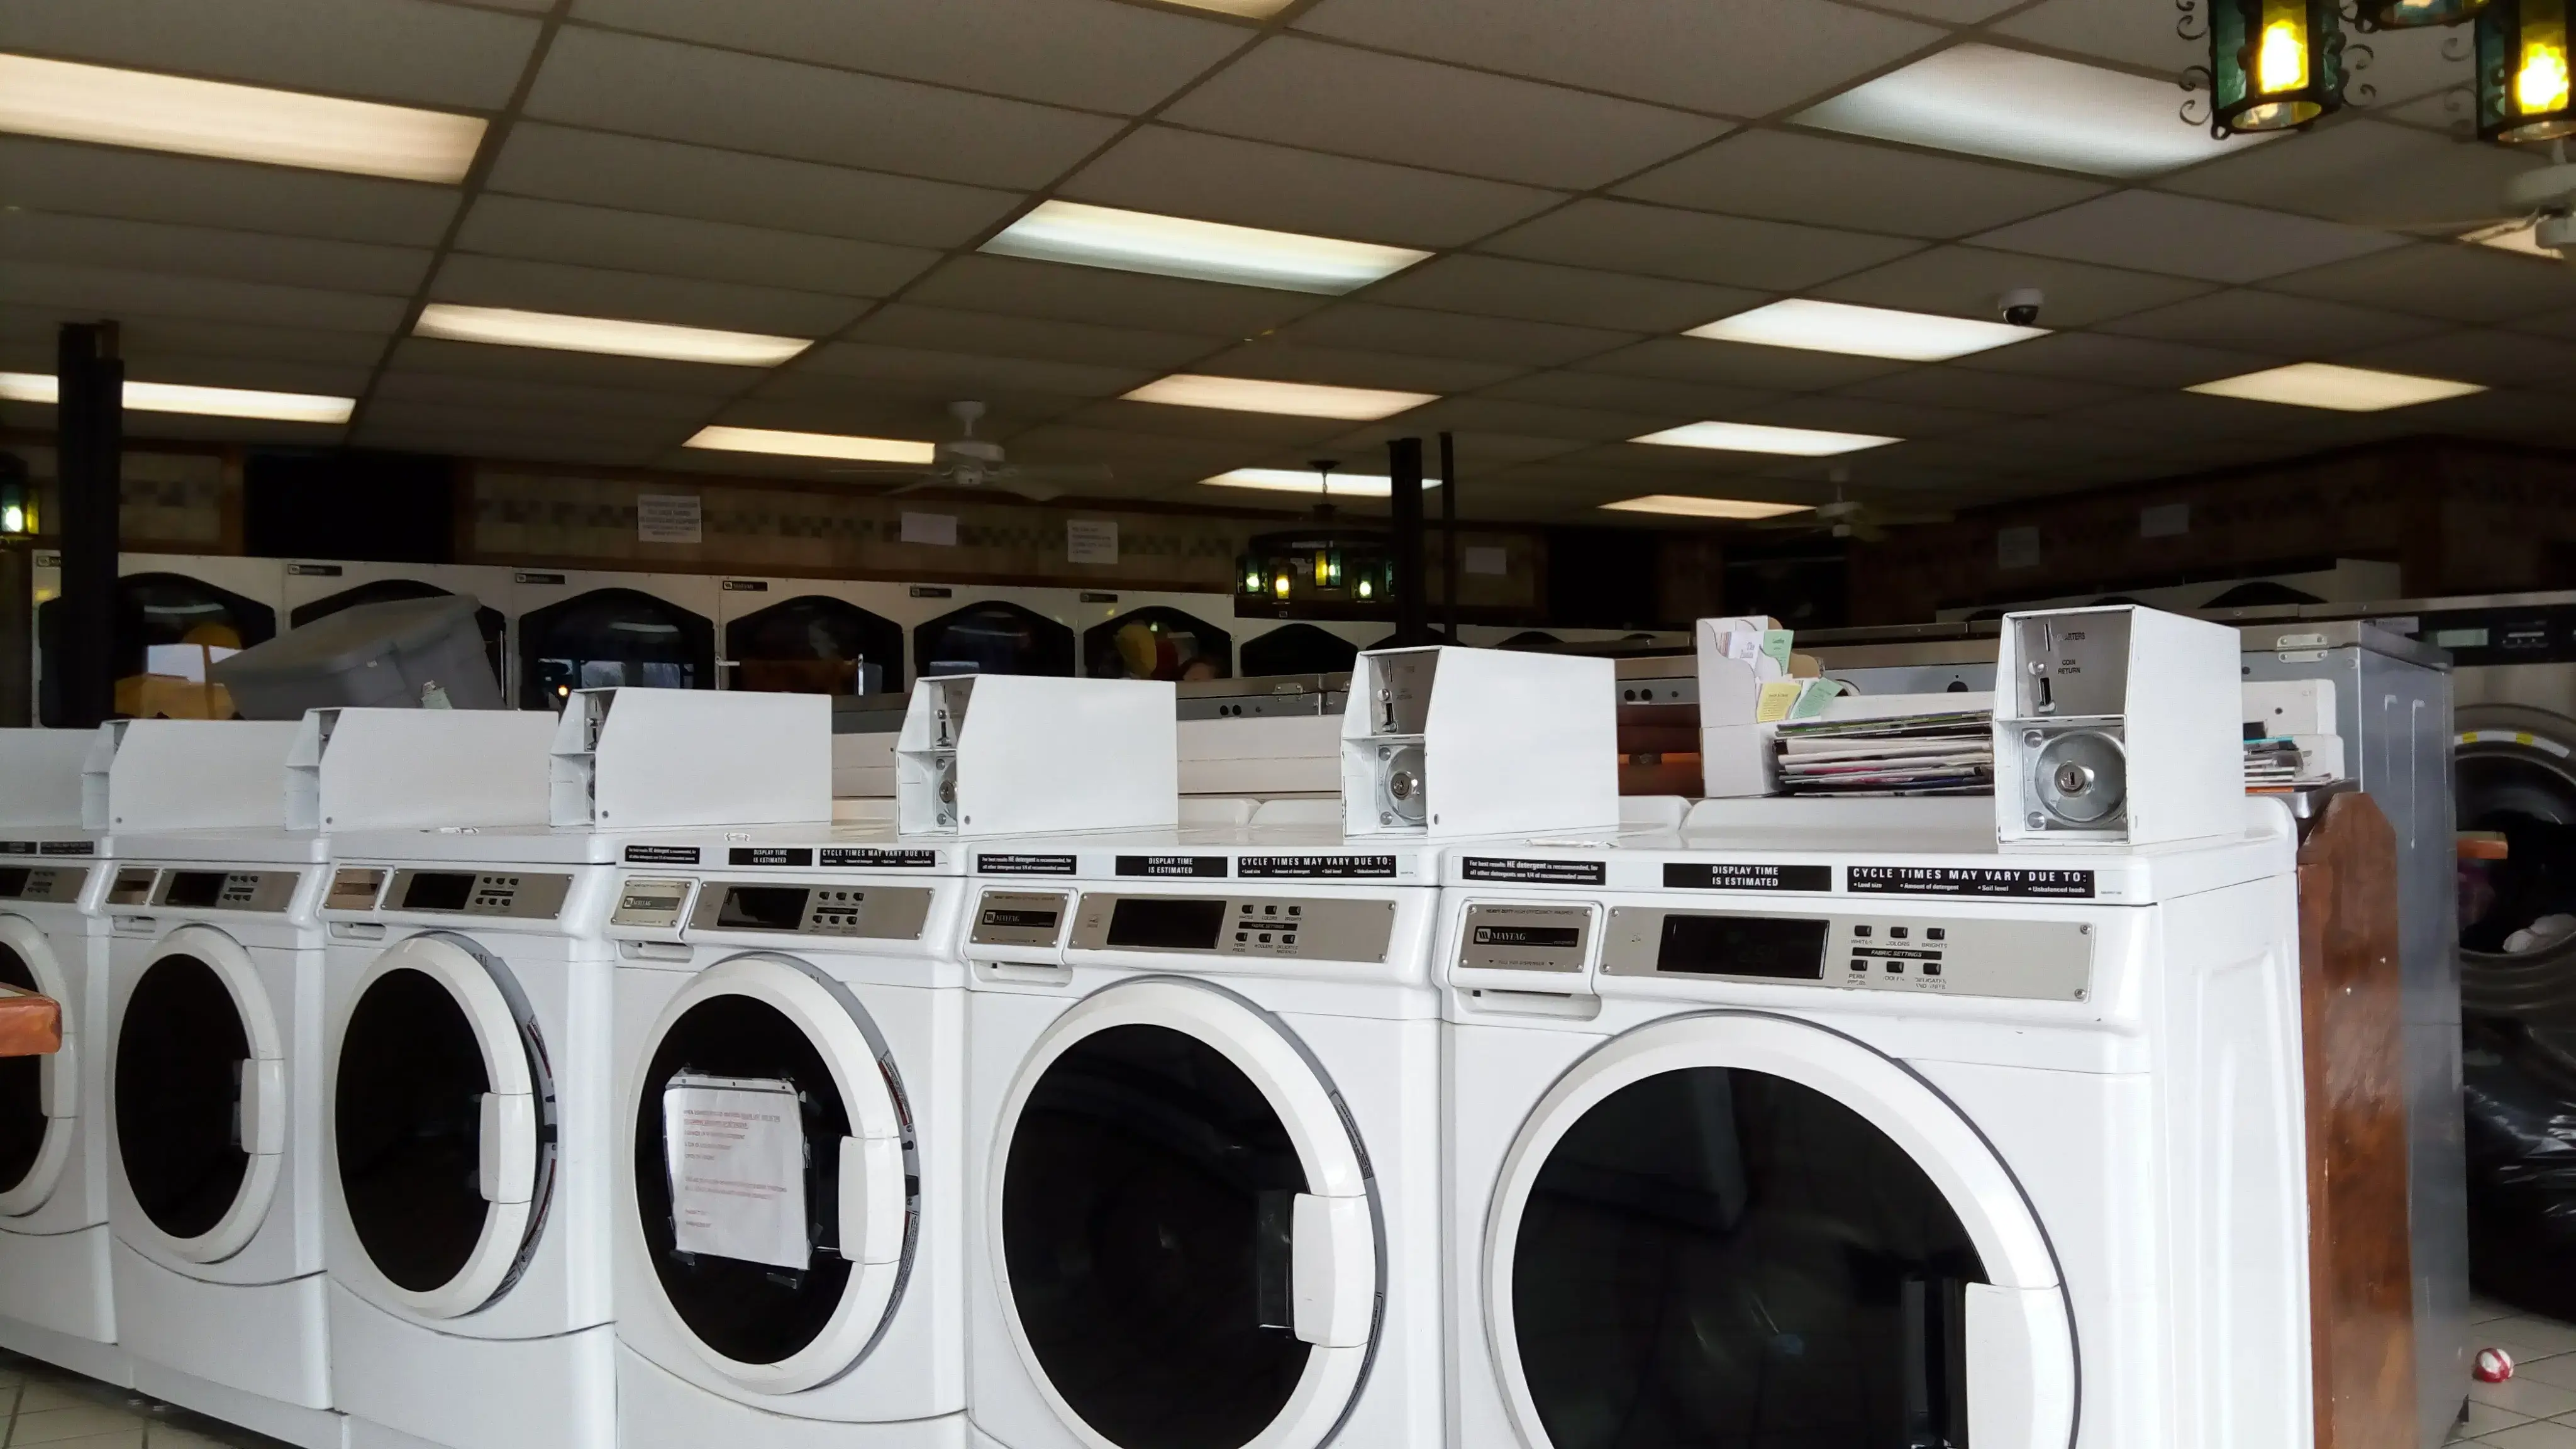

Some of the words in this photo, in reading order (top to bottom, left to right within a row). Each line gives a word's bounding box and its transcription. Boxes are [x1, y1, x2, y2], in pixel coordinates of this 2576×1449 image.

[2057, 631, 2085, 641] QARTERS
[1241, 857, 1268, 866] CYCLE
[1272, 857, 1299, 866] TIMES
[1303, 857, 1323, 866] MAY
[1326, 857, 1350, 865] VARY
[1354, 857, 1372, 865] DUE
[1376, 857, 1392, 865] TO:
[1516, 860, 1546, 870] detergent
[1490, 870, 1516, 878] detergents
[1712, 865, 1752, 875] DISPLAY
[1755, 866, 1779, 875] TIME
[1853, 867, 1894, 878] CYCLE
[1899, 869, 1941, 879] TIMES
[1949, 870, 1978, 880] MAY
[1985, 870, 2021, 881] VARY
[2028, 872, 2056, 882] DUE
[2063, 872, 2087, 882] TO:
[1712, 877, 1721, 886] IS
[1724, 877, 1779, 887] ESTIMATED
[1932, 883, 1959, 891] detergent
[1491, 931, 1526, 941] MAYTAG
